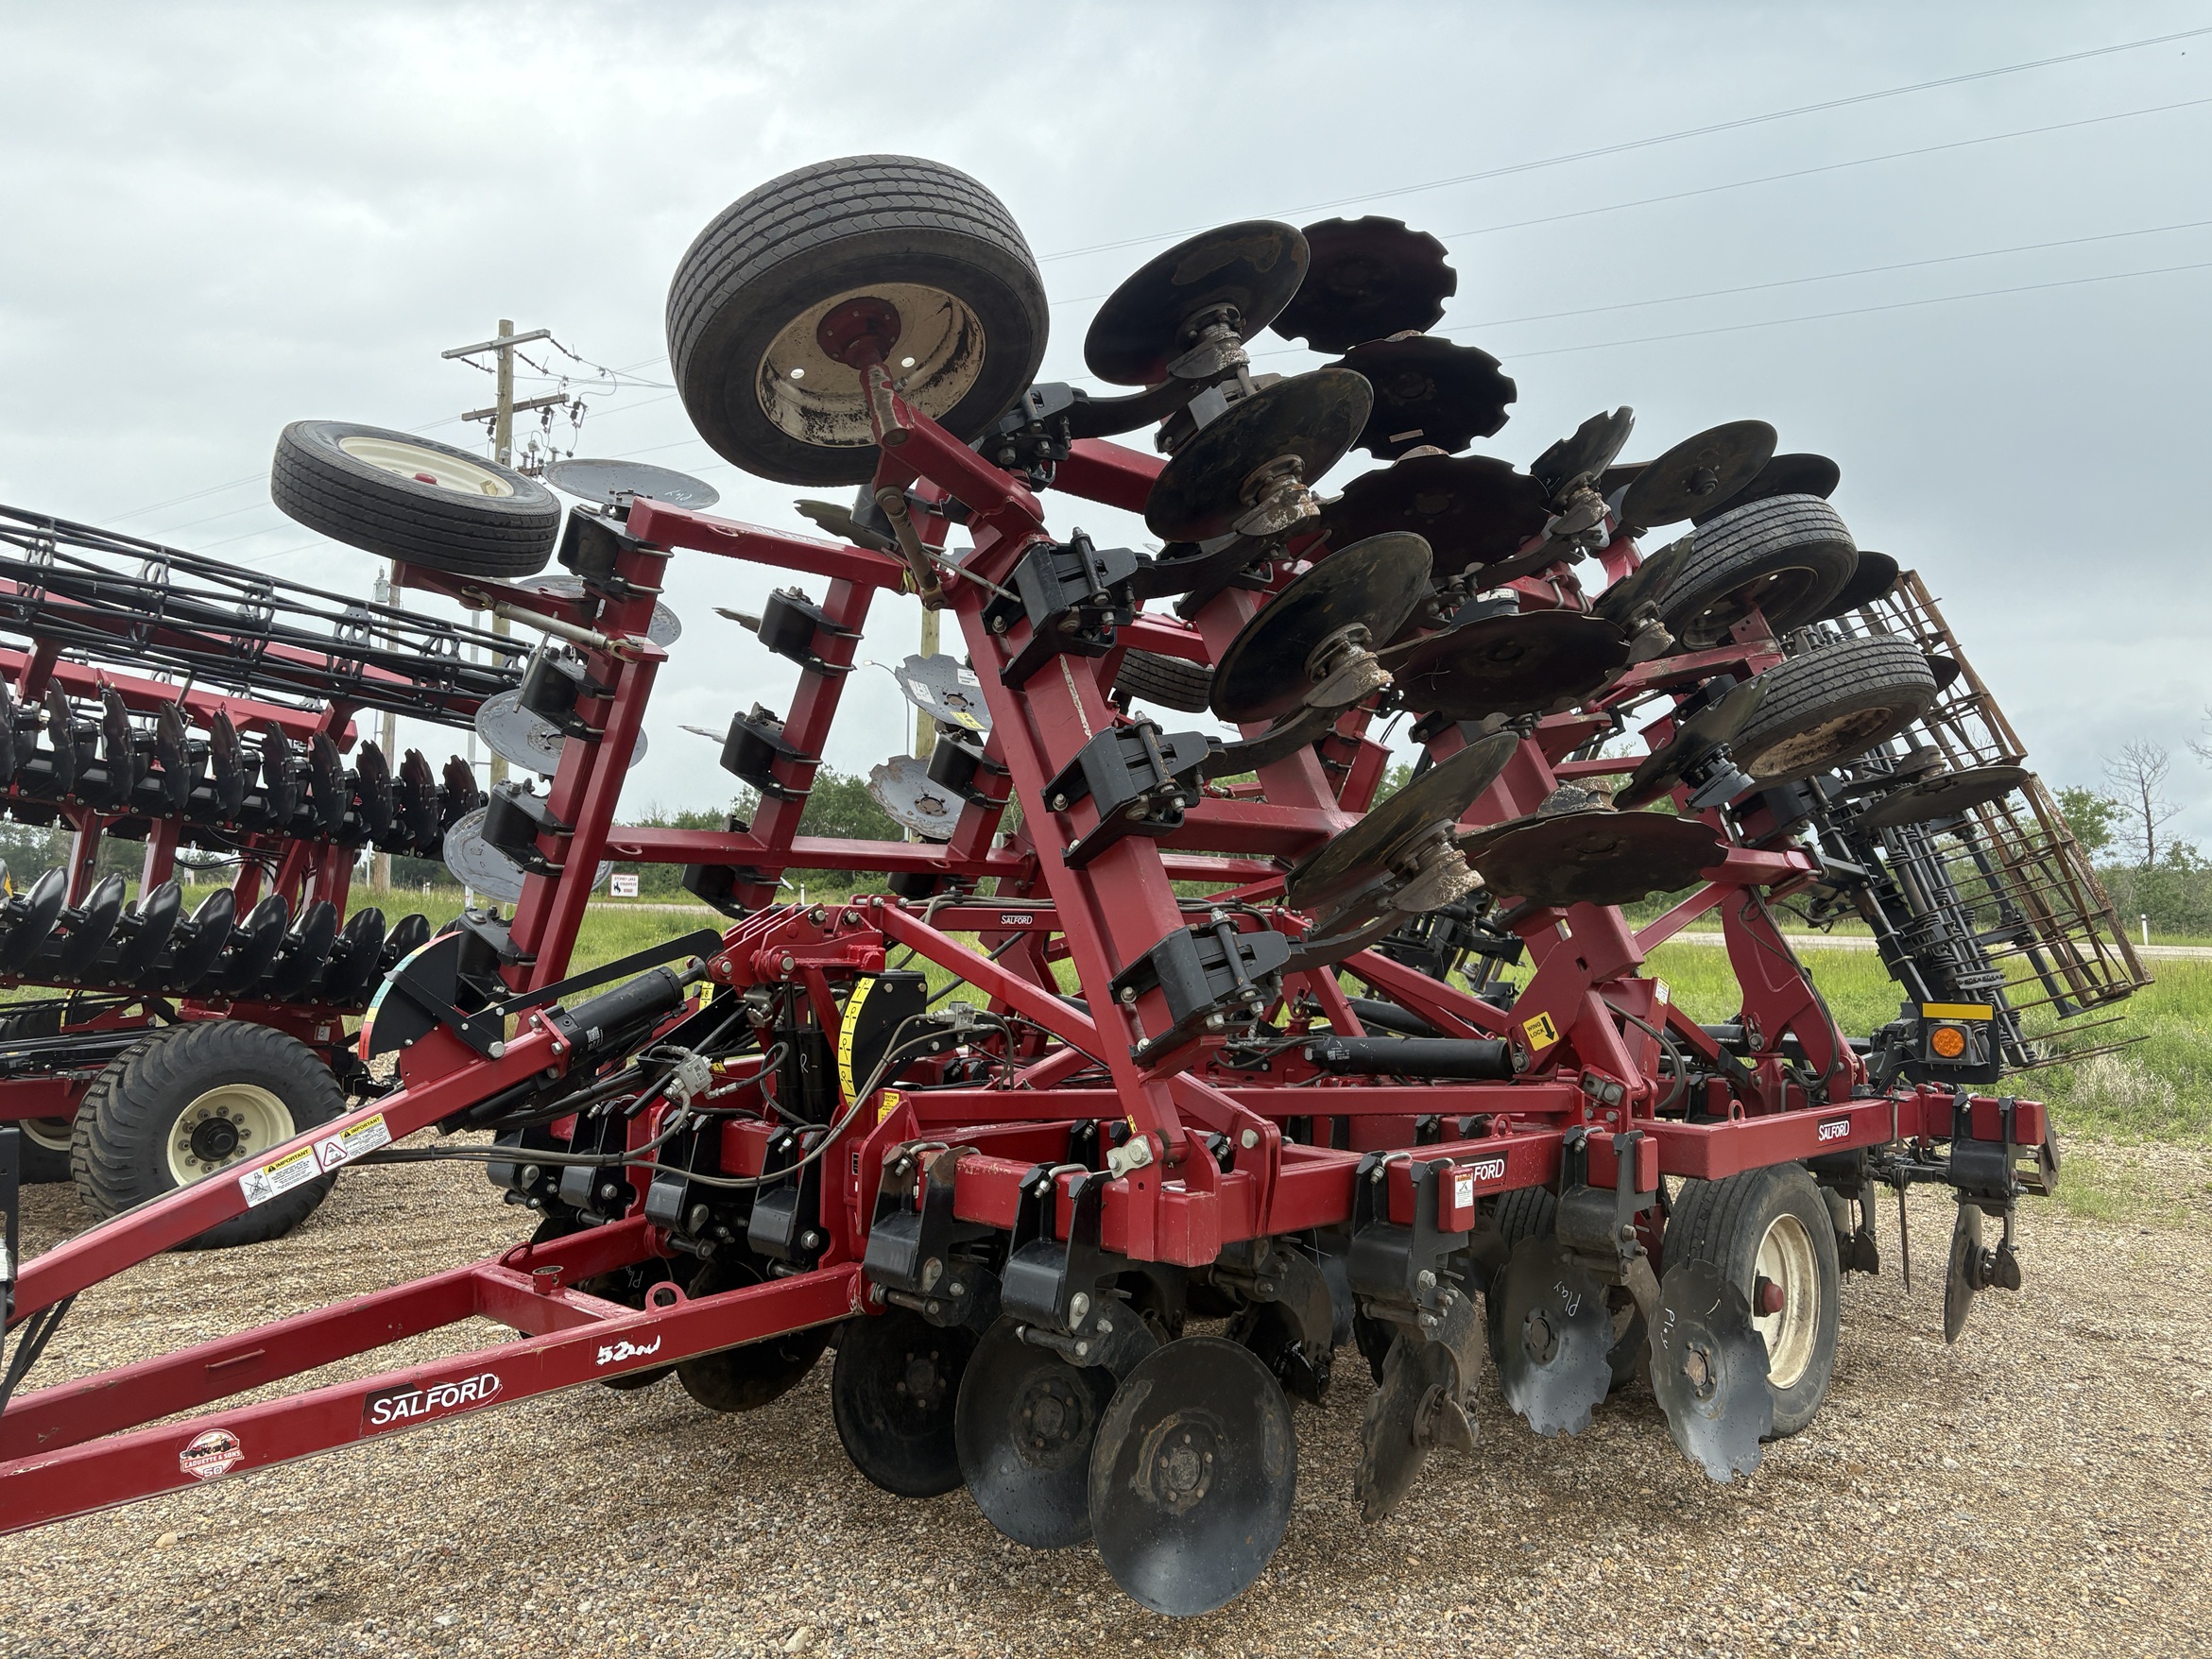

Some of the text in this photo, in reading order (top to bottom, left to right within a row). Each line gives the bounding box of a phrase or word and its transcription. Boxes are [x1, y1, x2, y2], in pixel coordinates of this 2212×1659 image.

[1001, 915, 1033, 925] SALFORD
[704, 990, 710, 999] 8
[1529, 1028, 1545, 1039] LOCK
[351, 1117, 381, 1134] IMPORTANT
[1818, 1120, 1850, 1142] SALFORD
[275, 1149, 309, 1169] IMPORTANT
[1473, 1158, 1505, 1182] FORD
[370, 1373, 500, 1425] SALFORD
[223, 1449, 241, 1460] SONS
